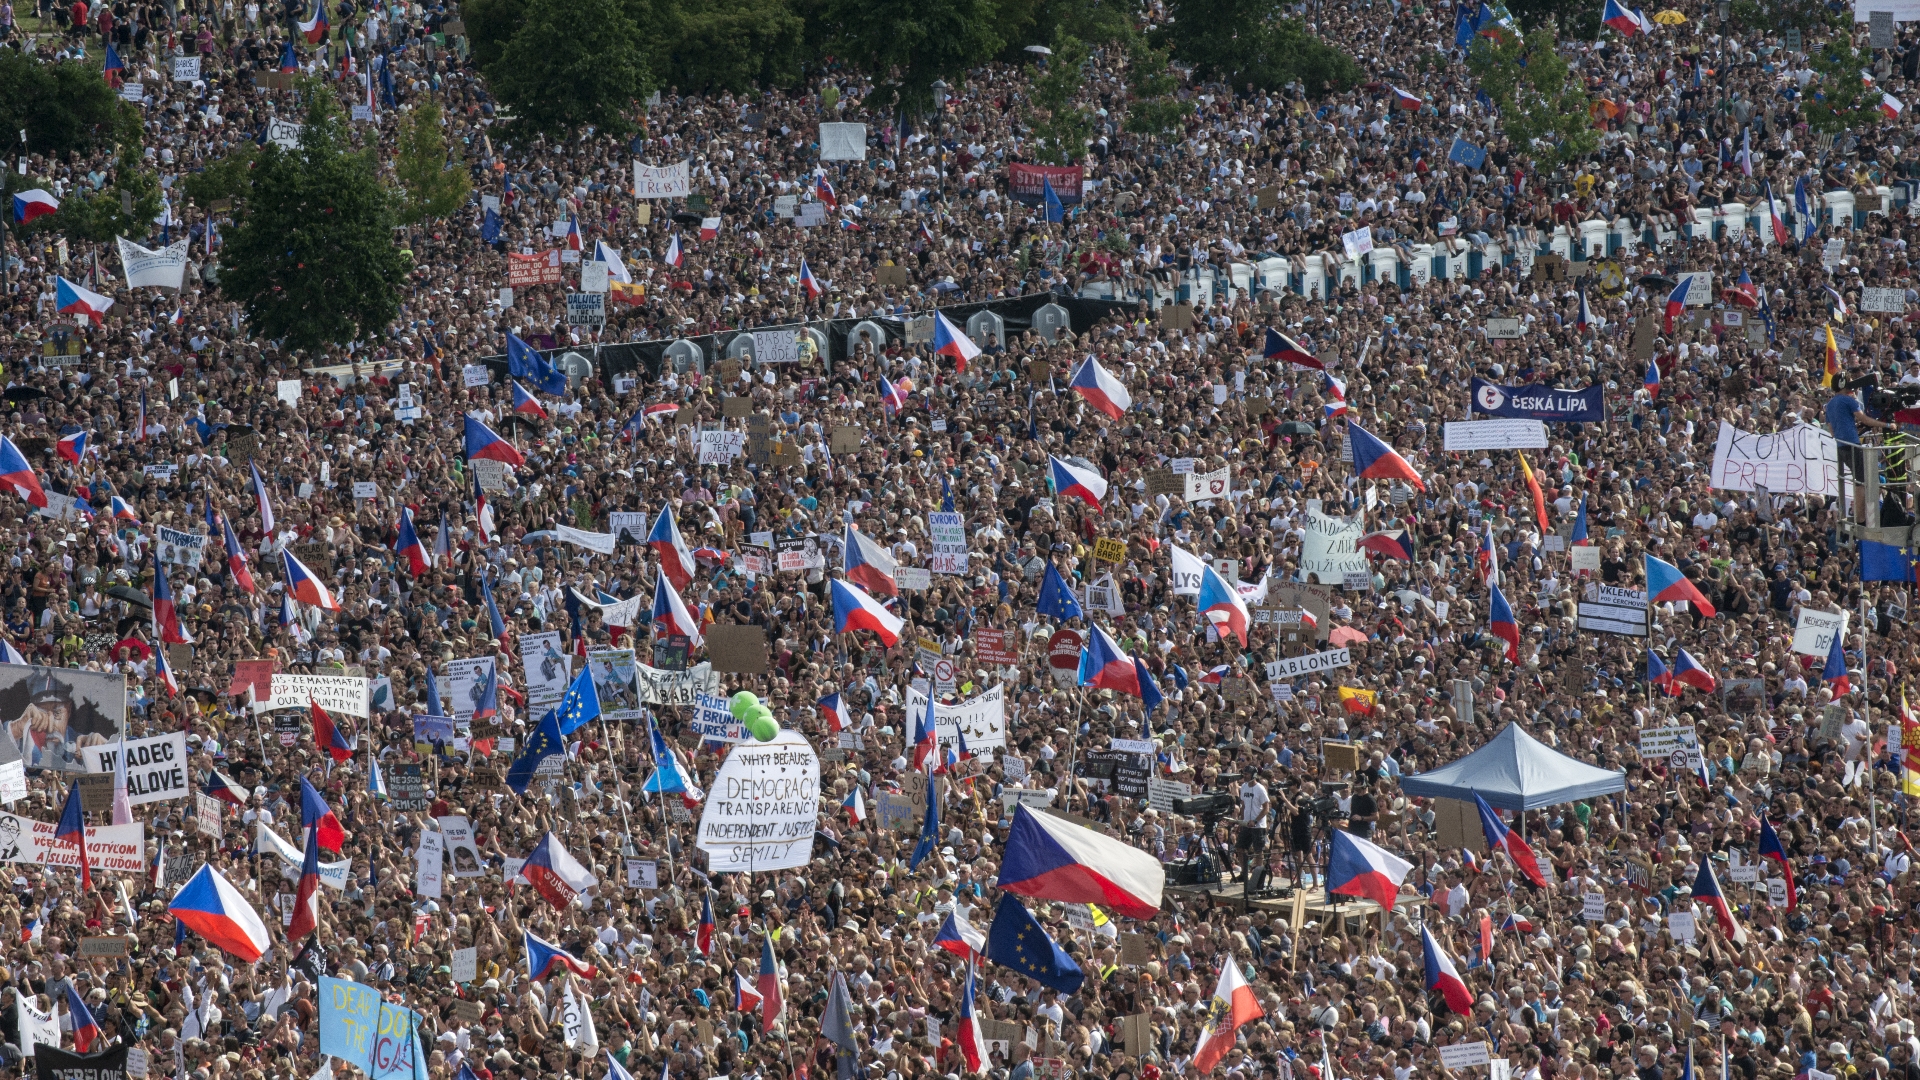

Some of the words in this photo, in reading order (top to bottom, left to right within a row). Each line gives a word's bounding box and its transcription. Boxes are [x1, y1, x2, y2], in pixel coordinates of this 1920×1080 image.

[270, 119, 301, 140] ČERN
[1016, 170, 1065, 187] STYDME
[1064, 173, 1076, 187] SE
[1026, 185, 1044, 195] SVÉH
[756, 331, 793, 346] BABIŠ
[1512, 394, 1554, 411] ČESKÁ
[1558, 395, 1587, 412] LÍPA
[705, 433, 722, 444] KDO
[1726, 426, 1839, 462] KONCE
[713, 444, 729, 452] TEN
[702, 452, 731, 464] KRADE
[1722, 459, 1768, 489] PRO
[779, 540, 803, 548] STYDÍM
[1099, 539, 1122, 552] STOP
[1096, 548, 1121, 562] BABIŠ
[1815, 634, 1834, 650] DEM
[1268, 651, 1348, 677] JABLONEC
[271, 684, 288, 695] TOP
[292, 685, 361, 700] DEVASTATING
[541, 692, 562, 701] ANOFE
[277, 696, 300, 706] OUR
[695, 693, 731, 712] PŘIJEL
[911, 696, 927, 706] AN
[693, 708, 700, 720] Z
[934, 715, 962, 726] EDNO
[727, 726, 739, 739] od
[738, 753, 771, 766] WHY?
[127, 763, 185, 798] ÁLOVÉ
[389, 776, 421, 784] NEJSOU
[473, 771, 500, 787] DEMIS
[727, 776, 817, 802] DEMOCRACY
[717, 799, 817, 816] TRANSPARENCY
[706, 822, 778, 838] INDEPENDENT
[36, 852, 44, 862] A
[729, 842, 794, 862] SEMILY
[544, 870, 575, 903] SUŠICE
